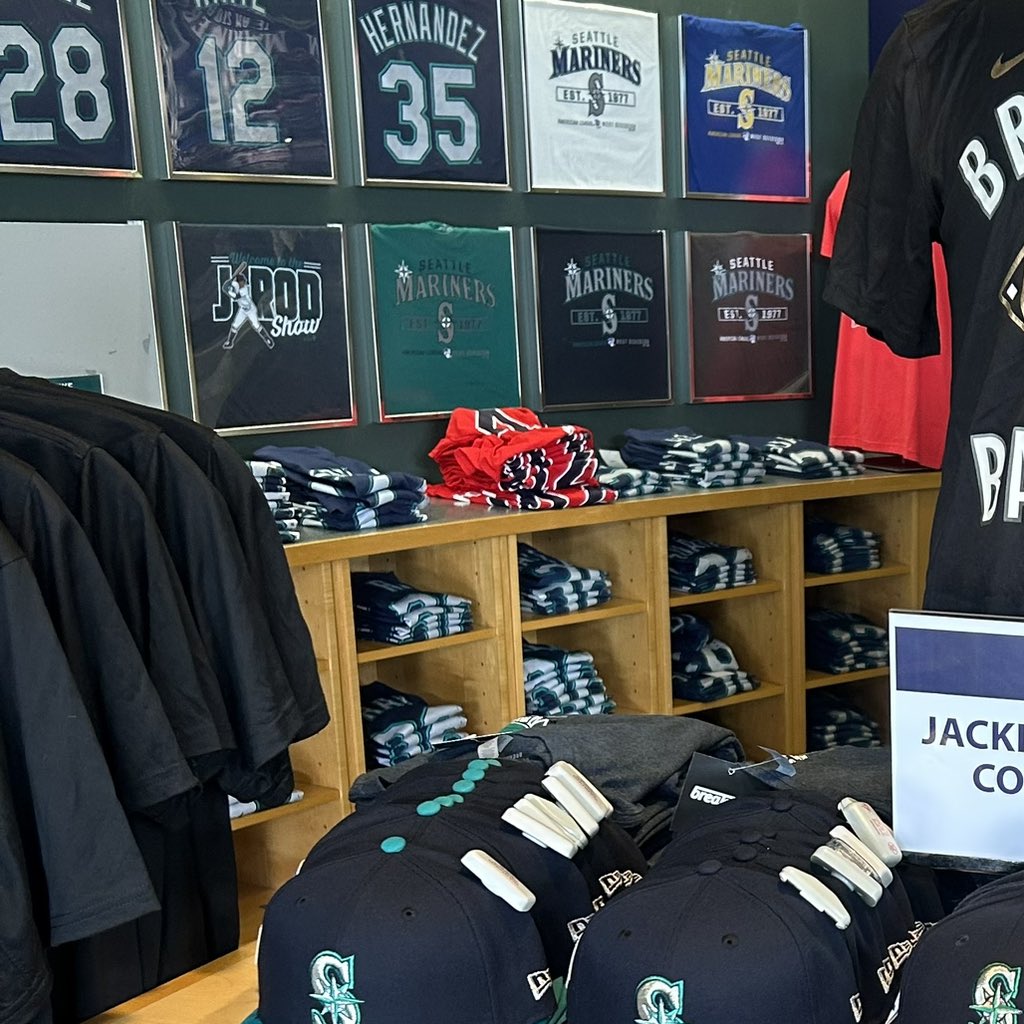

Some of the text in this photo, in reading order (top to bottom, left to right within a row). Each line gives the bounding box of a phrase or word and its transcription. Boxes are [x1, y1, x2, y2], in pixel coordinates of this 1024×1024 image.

[358, 0, 487, 63] HERNANDEZ
[572, 31, 619, 48] SEATTLE
[548, 44, 642, 87] MARINERS
[726, 49, 772, 67] SEATTLE
[0, 20, 115, 144] 28
[196, 34, 281, 145] 12
[563, 89, 586, 101] EST.
[700, 61, 792, 102] MARINERS
[377, 60, 482, 166] 35
[418, 259, 471, 275] SEATTLE
[729, 256, 775, 272] SEATTLE
[395, 273, 496, 308] MARINERS
[563, 266, 654, 305] MARINERS
[711, 269, 795, 303] MARINERS
[270, 315, 320, 338] Show
[761, 309, 782, 320] 1977
